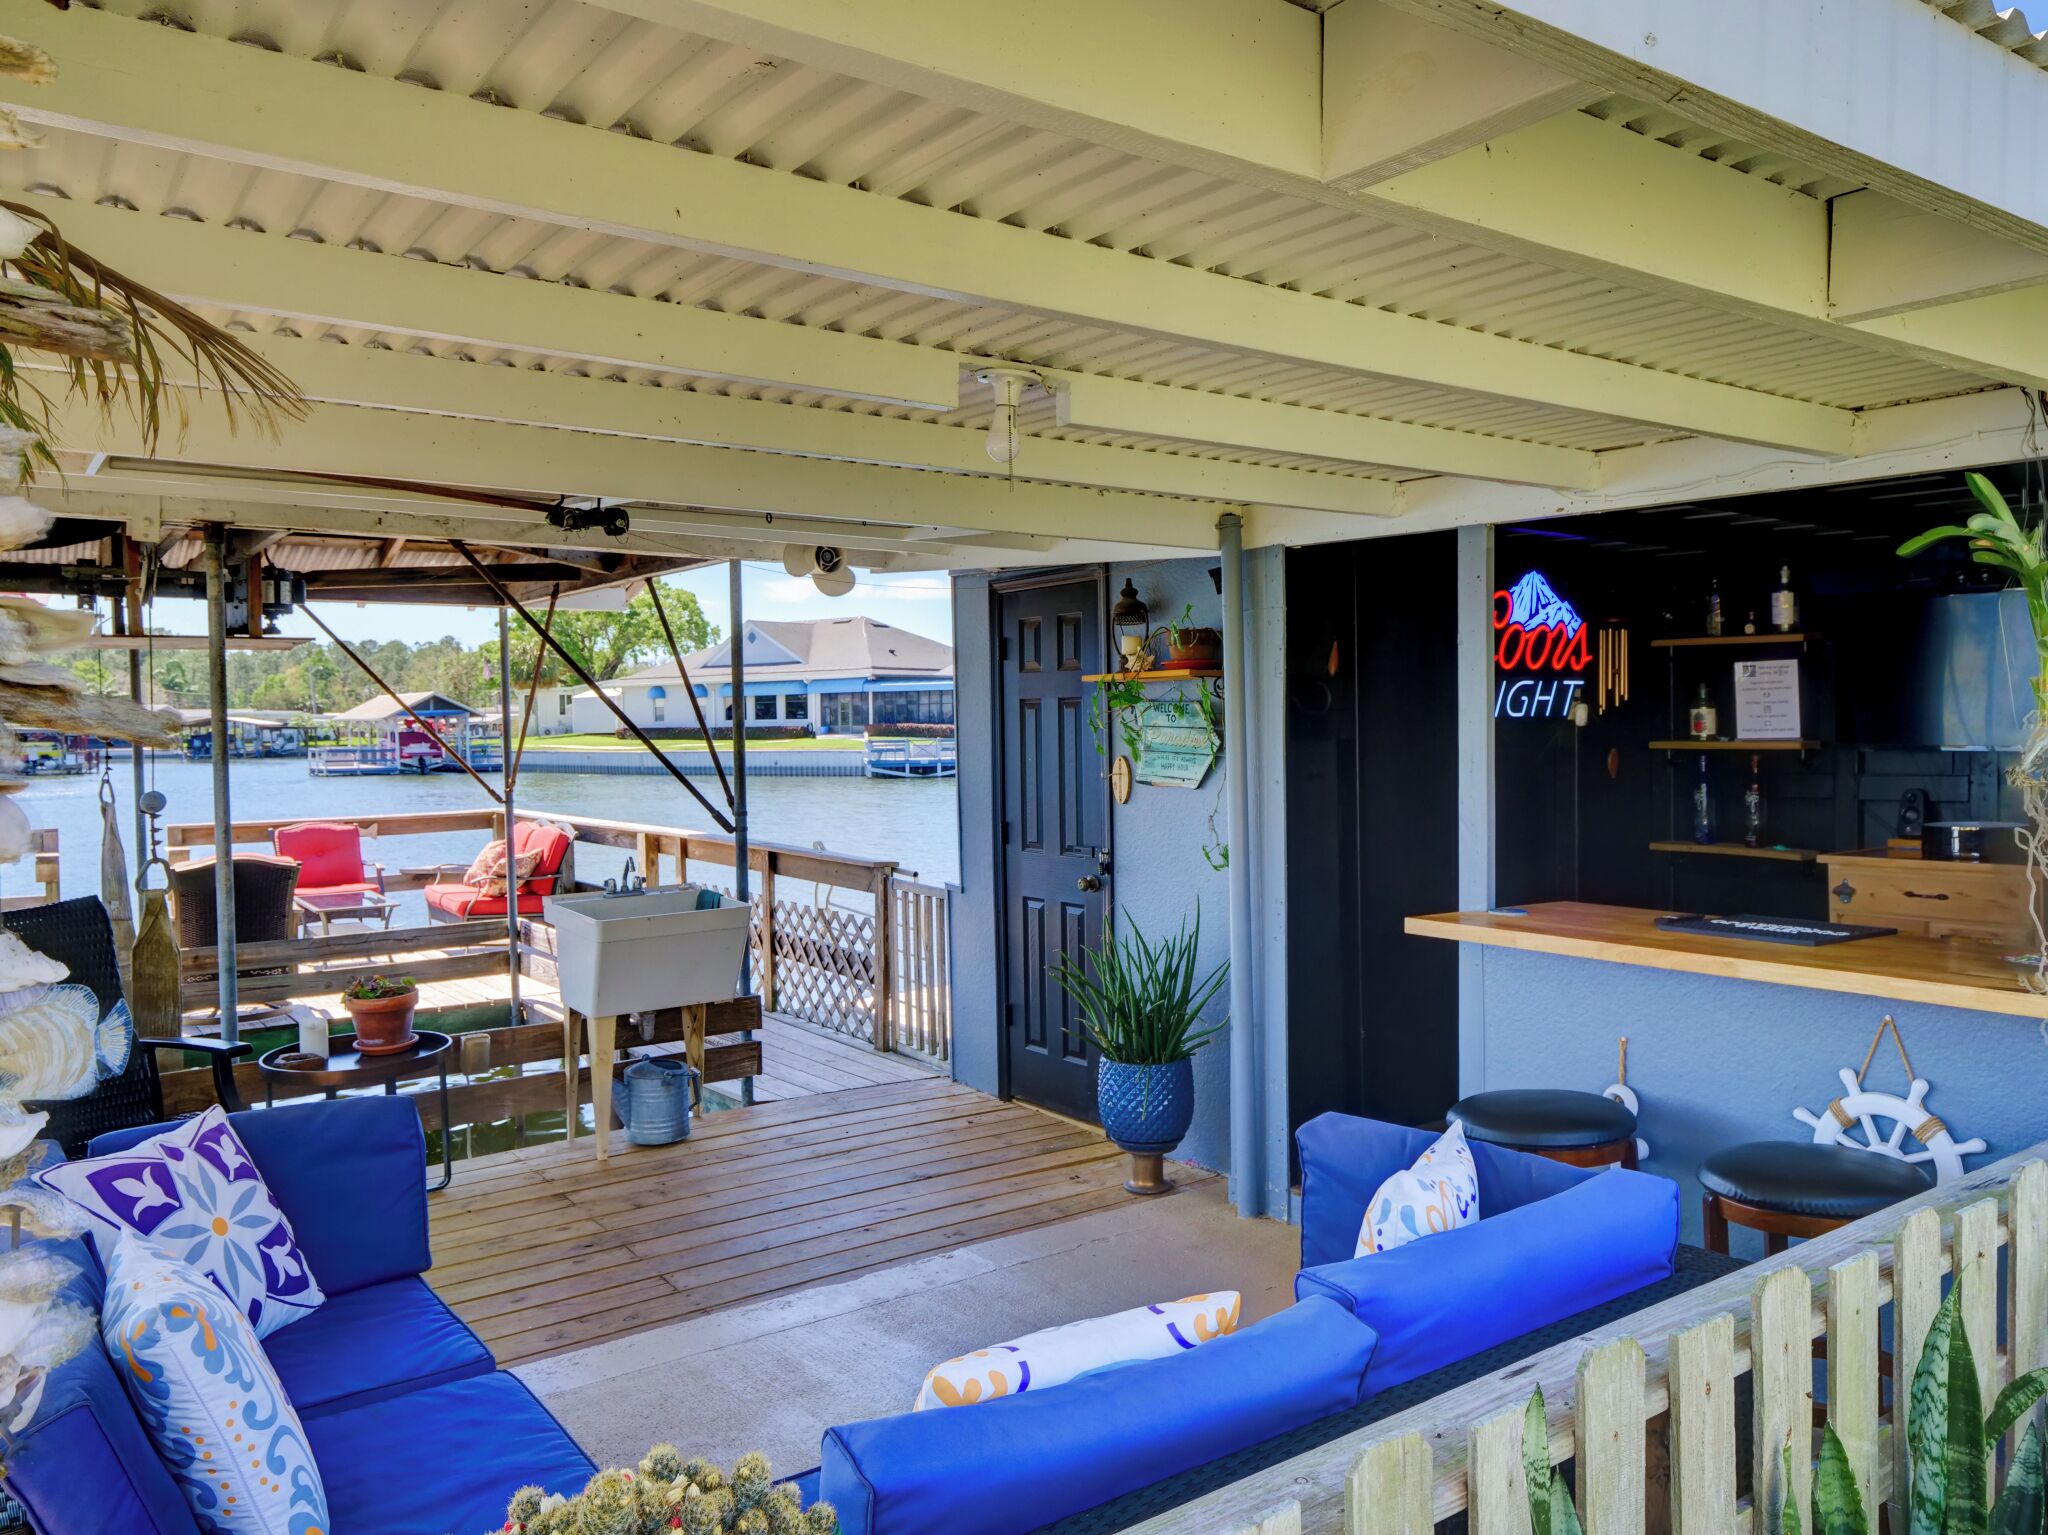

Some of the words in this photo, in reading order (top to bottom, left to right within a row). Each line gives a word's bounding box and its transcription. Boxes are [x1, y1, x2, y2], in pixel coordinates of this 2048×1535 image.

[1153, 703, 1190, 714] WELCME
[1494, 680, 1585, 718] IGHT
[1166, 714, 1177, 723] TO
[1150, 721, 1208, 748] Paradise
